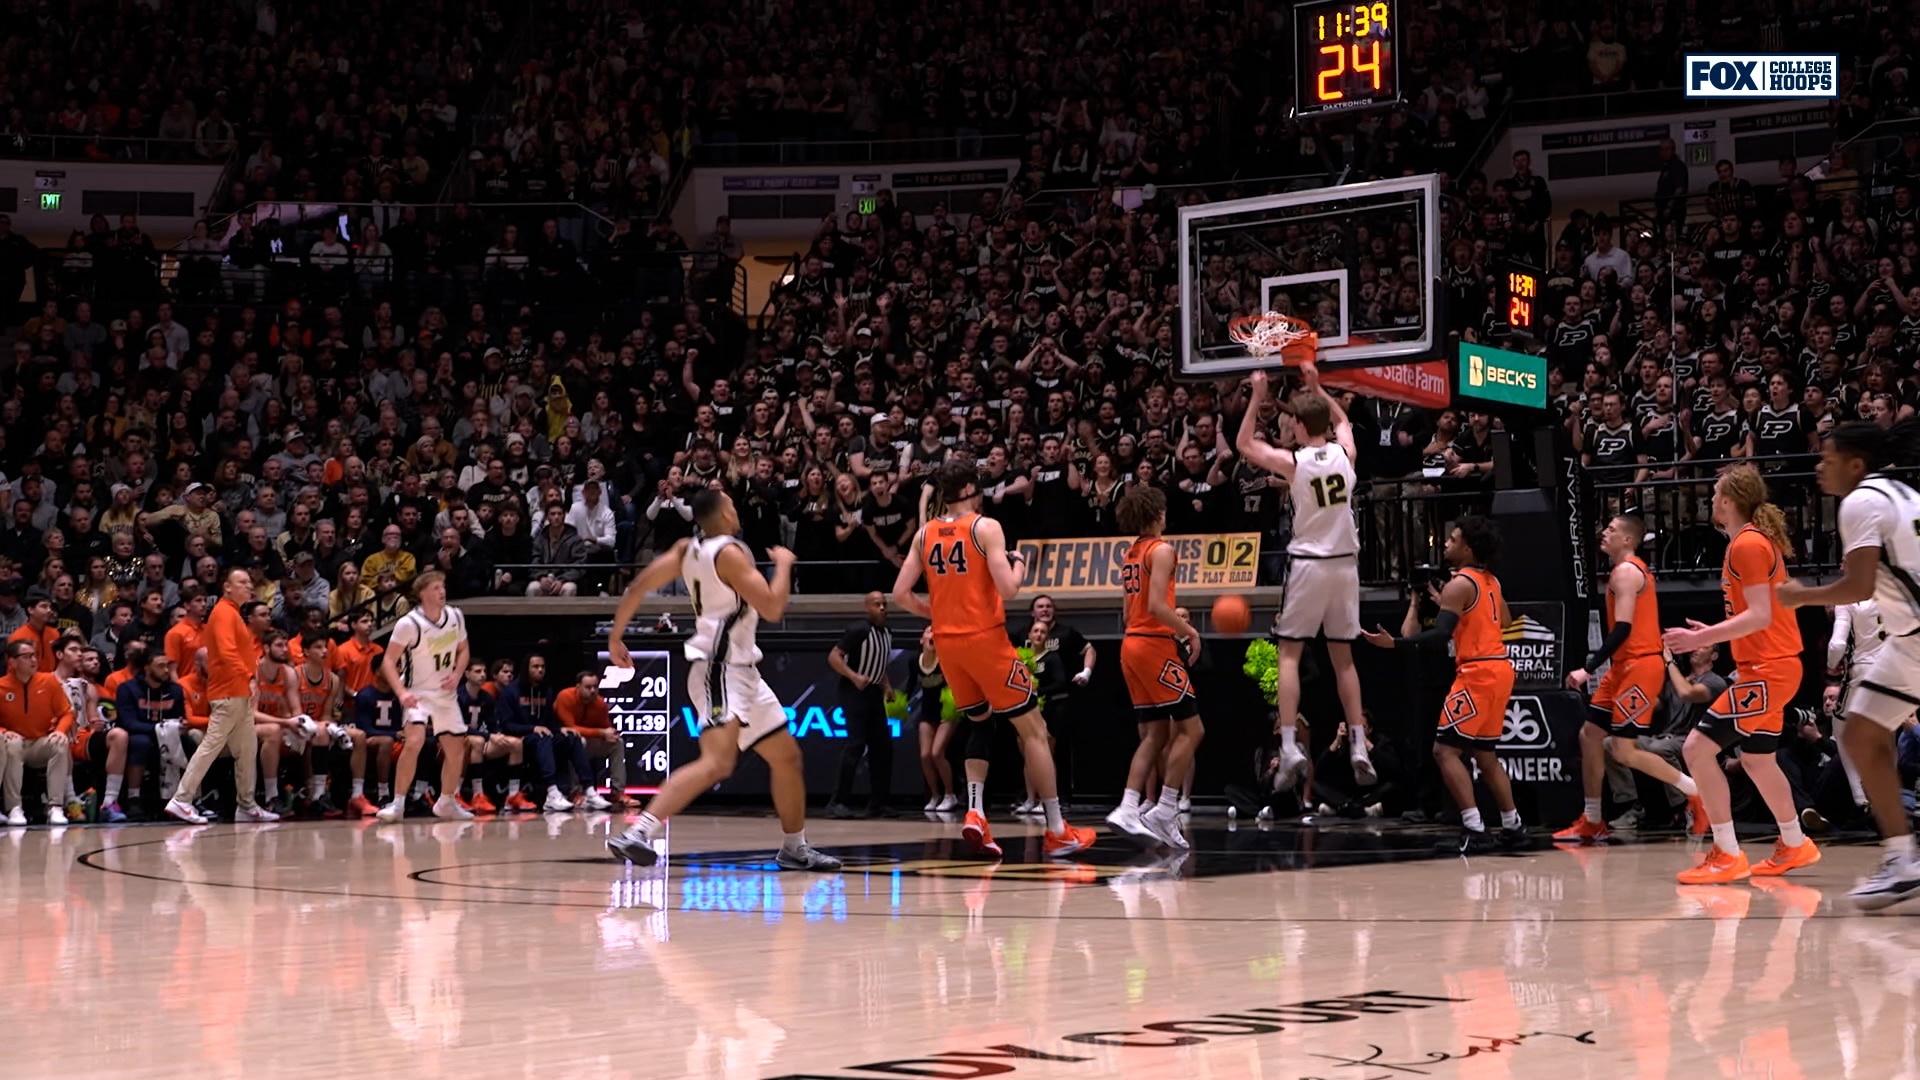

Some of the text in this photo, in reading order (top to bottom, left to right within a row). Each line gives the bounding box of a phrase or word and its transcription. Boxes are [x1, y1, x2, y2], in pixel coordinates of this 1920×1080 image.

[1318, 2, 1388, 41] 11:39
[1318, 40, 1380, 101] 24
[1323, 98, 1373, 111] DAKTRONICS
[41, 193, 61, 211] EXIT
[858, 197, 877, 215] EXIT
[1510, 296, 1530, 327] 24
[1383, 365, 1445, 396] State Farm
[1487, 366, 1537, 389] BECK'S
[1705, 423, 1731, 442] P
[1760, 420, 1793, 439] P
[1597, 438, 1626, 456] P
[1310, 474, 1347, 507] 12
[1562, 456, 1588, 599] ROHRMAN
[928, 541, 967, 575] 44
[1020, 541, 1132, 587] DEFENS
[1122, 563, 1140, 594] 23
[1203, 571, 1253, 583] PLAY HARD
[1506, 644, 1555, 658] RDUE
[433, 652, 452, 671] 14
[1511, 659, 1554, 671] DERAL
[641, 677, 667, 697] 20
[613, 715, 665, 731] 11:39
[641, 751, 667, 771] 16
[1062, 990, 1473, 1047] COURT
